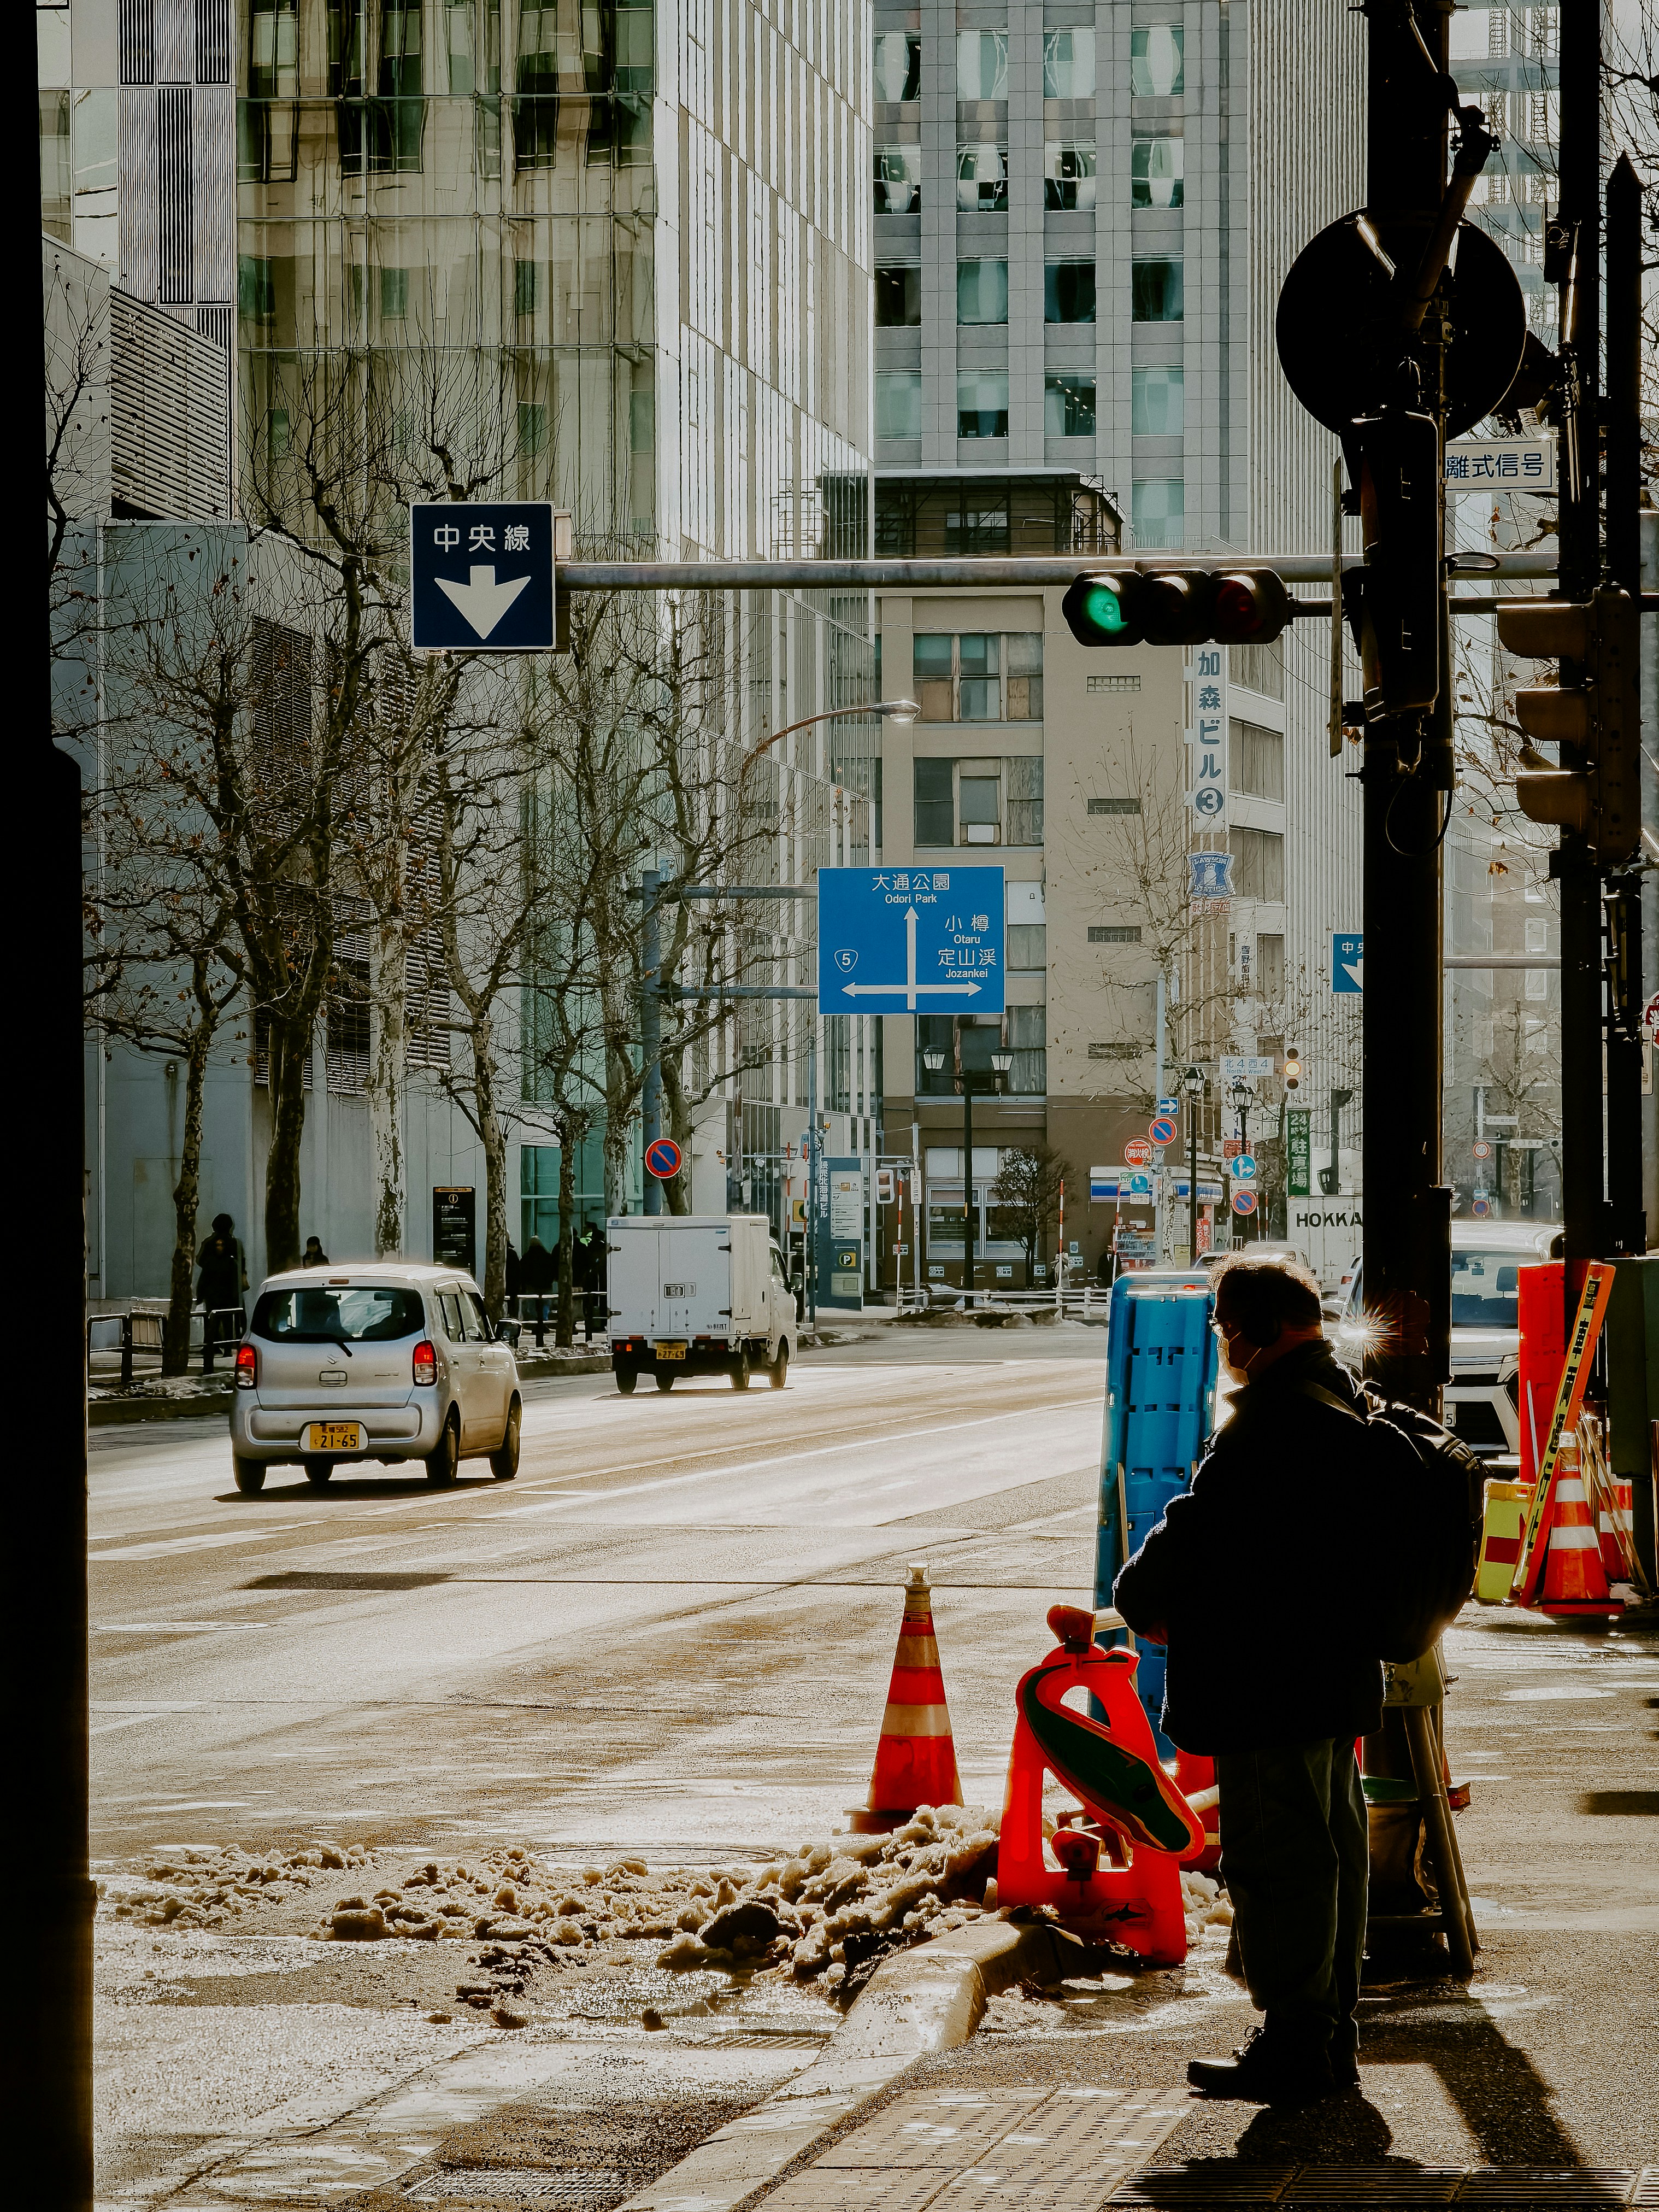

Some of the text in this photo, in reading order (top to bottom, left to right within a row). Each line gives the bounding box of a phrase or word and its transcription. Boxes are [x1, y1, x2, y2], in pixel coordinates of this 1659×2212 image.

[434, 524, 530, 553] 中央線
[872, 873, 950, 891] 大通公園
[885, 894, 938, 903] Odori Park
[944, 914, 990, 932] 小樽
[954, 934, 981, 944] Otaru
[842, 953, 851, 966] 5
[938, 948, 997, 966] 定山渓
[945, 968, 988, 978] Jozankei
[321, 1434, 357, 1448] 21-65
